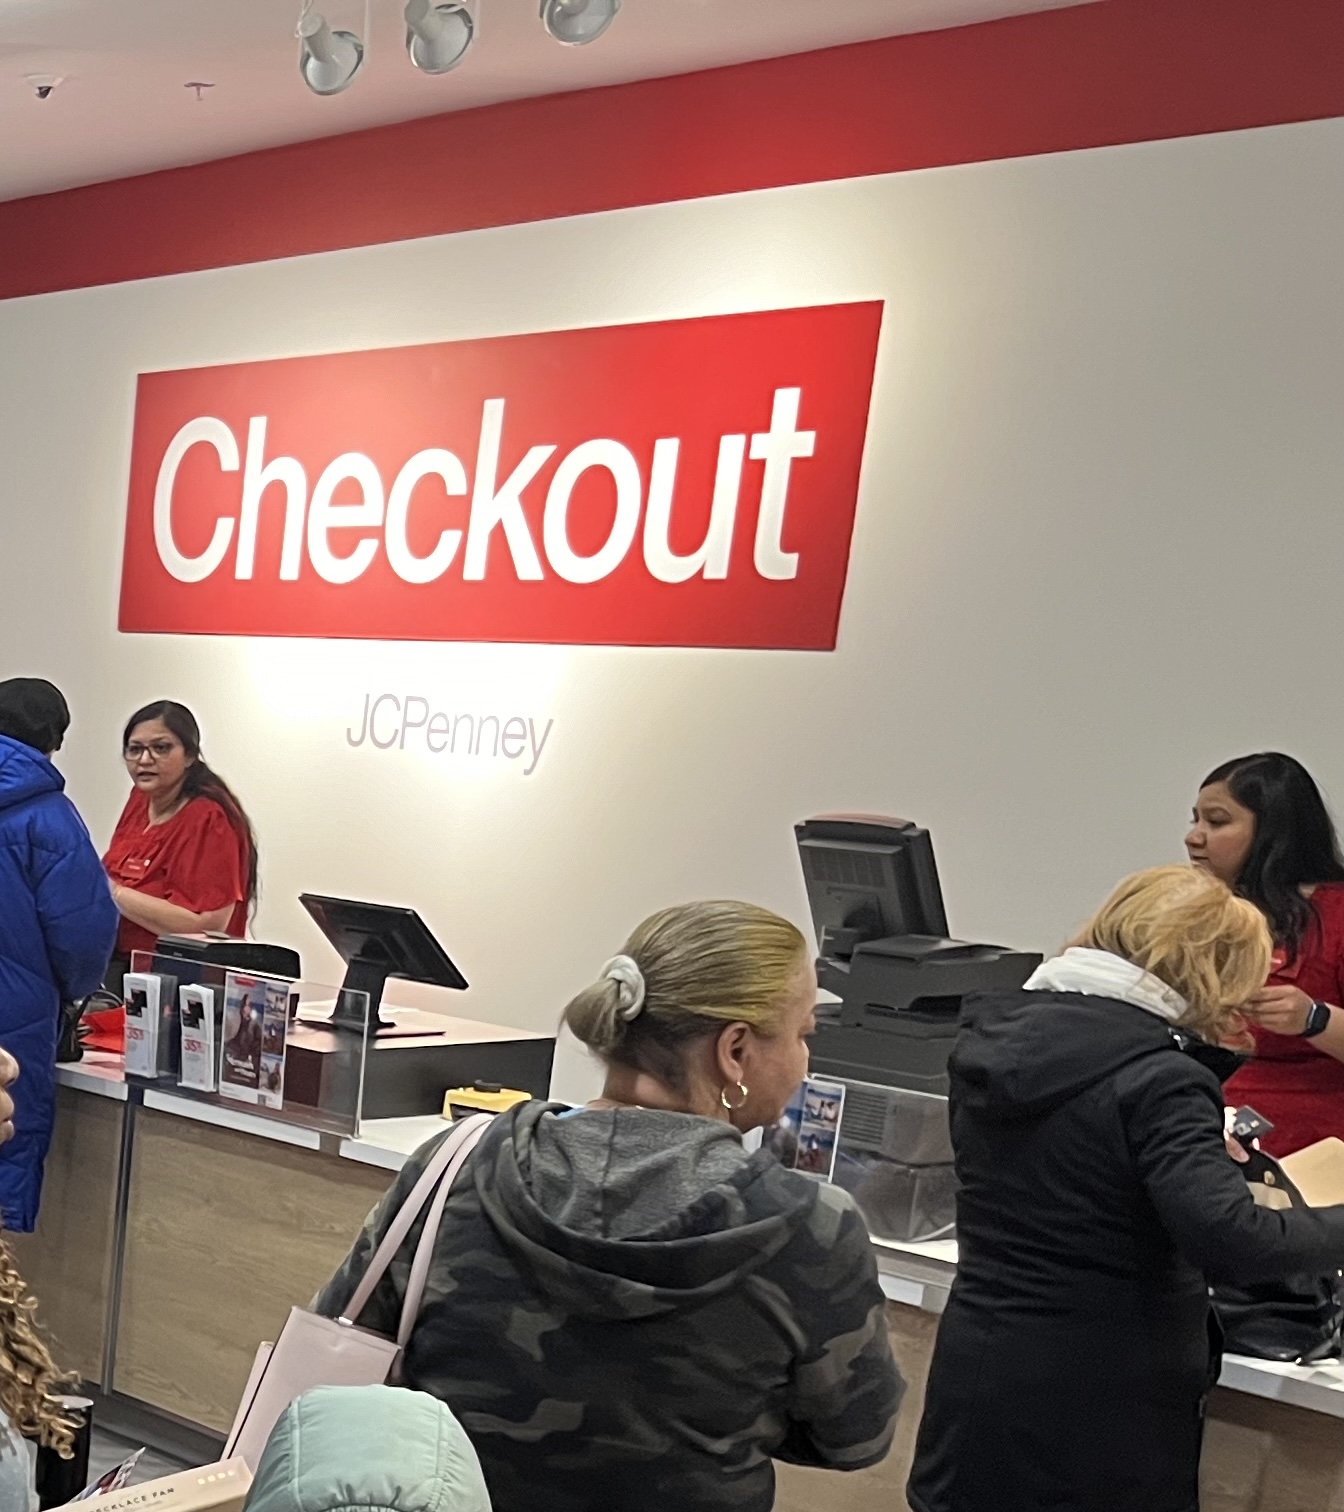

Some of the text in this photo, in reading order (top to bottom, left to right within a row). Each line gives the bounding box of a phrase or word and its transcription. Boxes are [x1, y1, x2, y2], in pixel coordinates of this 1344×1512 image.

[153, 386, 817, 585] Checkout
[346, 693, 555, 776] JCPenney
[152, 1486, 176, 1499] FAN
